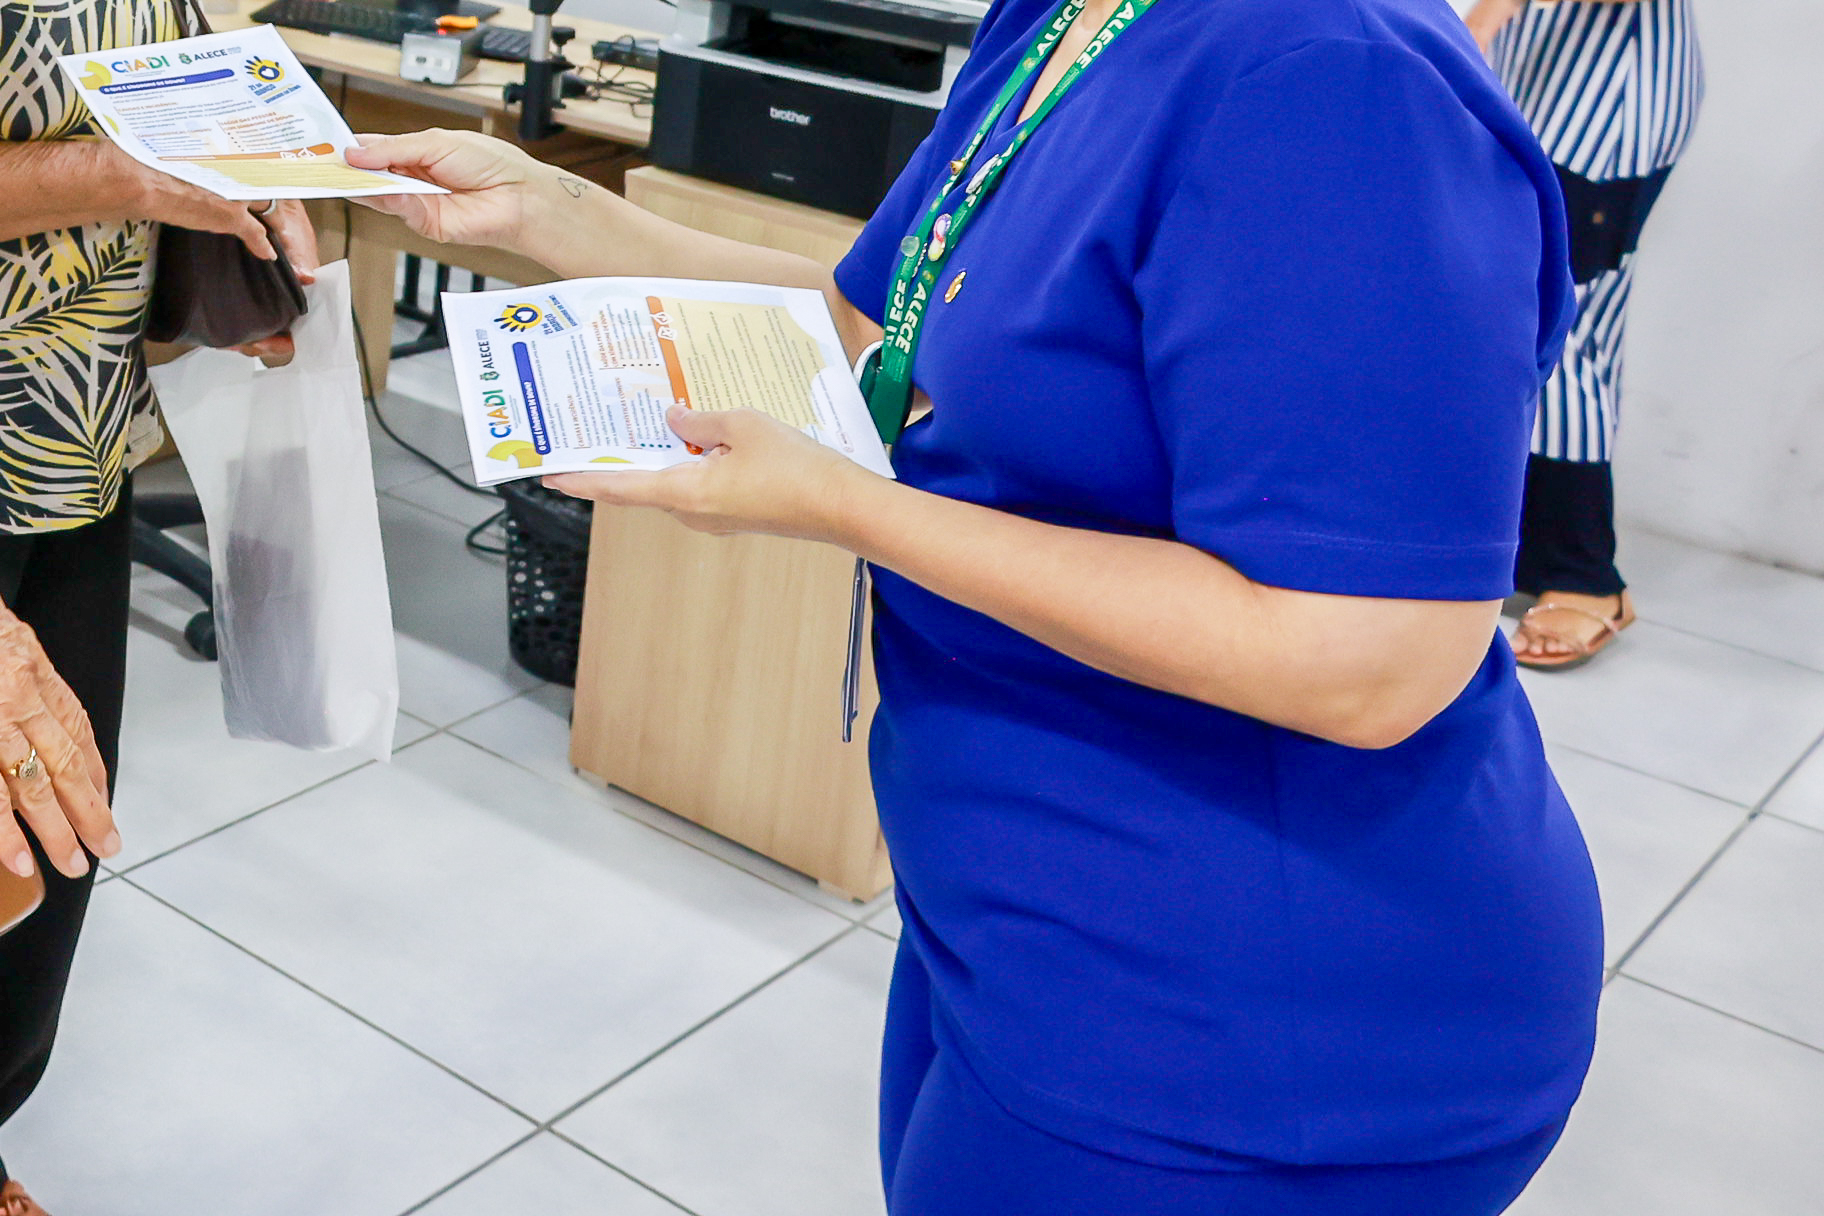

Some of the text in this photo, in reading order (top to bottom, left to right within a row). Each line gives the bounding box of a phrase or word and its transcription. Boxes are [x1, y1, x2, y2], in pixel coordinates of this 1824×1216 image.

[1075, 1, 1135, 69] ALECE
[111, 55, 170, 73] CIADI
[194, 49, 228, 61] ALECE
[769, 106, 811, 126] brother
[895, 282, 927, 354] ALECE
[478, 340, 495, 369] ALECE
[482, 389, 512, 438] CIADI
